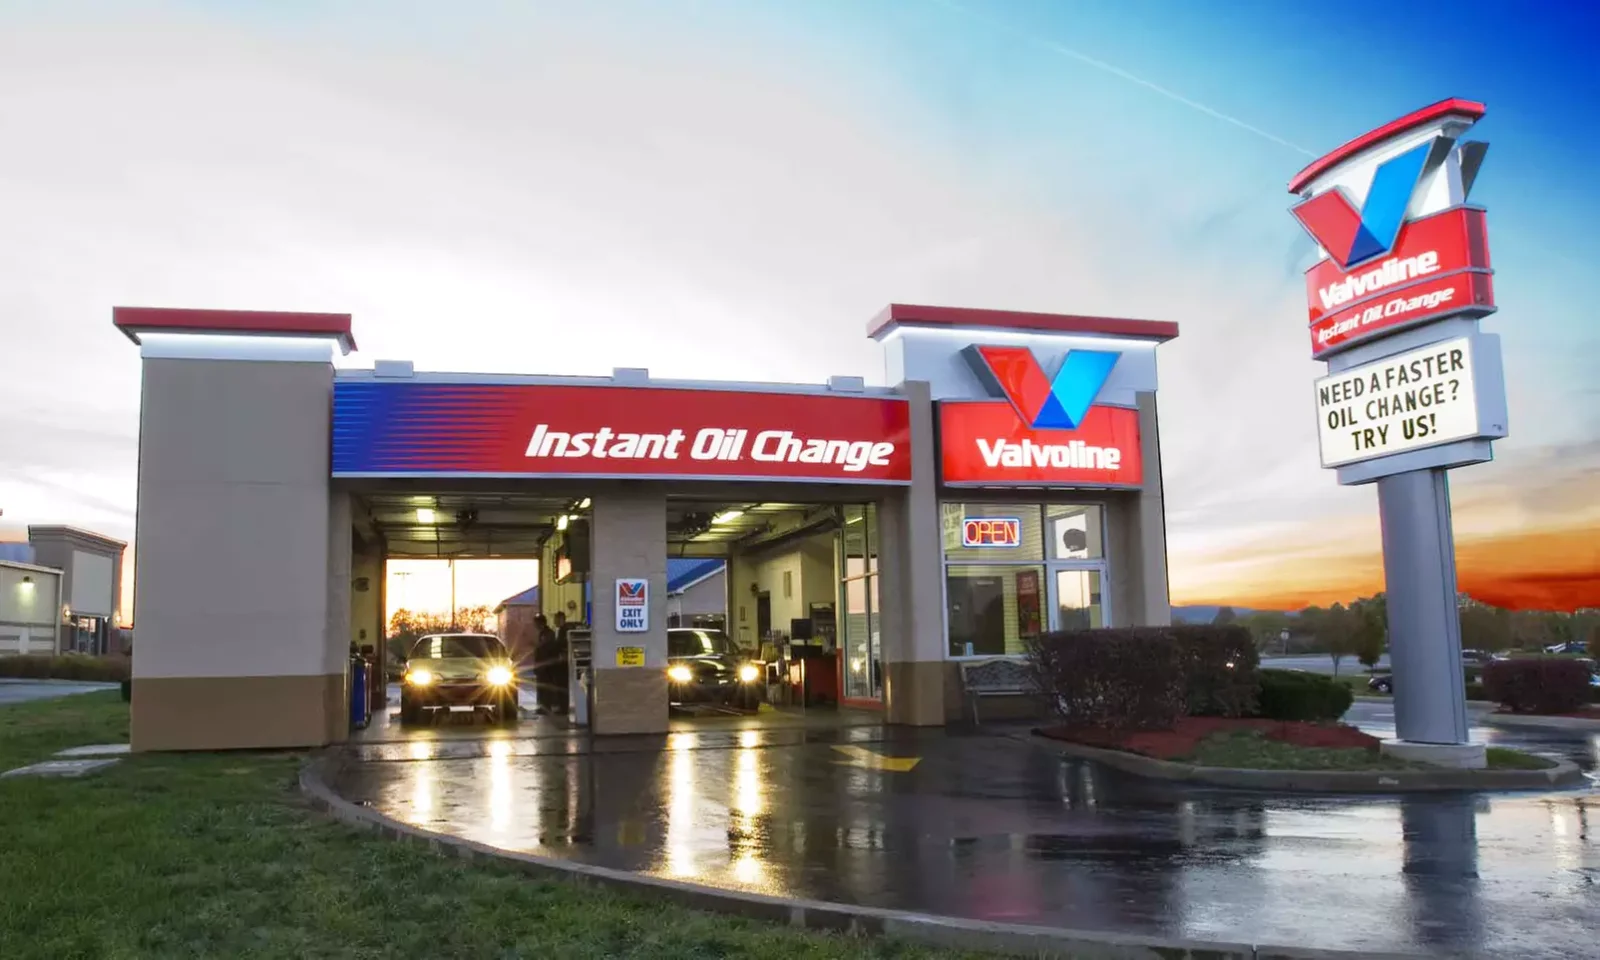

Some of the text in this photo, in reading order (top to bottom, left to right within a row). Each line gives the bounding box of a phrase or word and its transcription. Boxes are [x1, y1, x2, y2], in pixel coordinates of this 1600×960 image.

[1319, 250, 1438, 309] Valvoline
[1318, 312, 1360, 344] Instant
[1384, 287, 1455, 319] Change
[1319, 349, 1464, 407] NEED A FASTER
[1327, 379, 1460, 430] OIL CHANGE?
[525, 424, 895, 472] Instant Oil Change
[1352, 412, 1437, 451] TRY US!
[976, 438, 1122, 470] Valvoline
[964, 520, 1019, 544] OPEN
[620, 619, 644, 629] ONLY
[622, 608, 642, 618] EXIT
